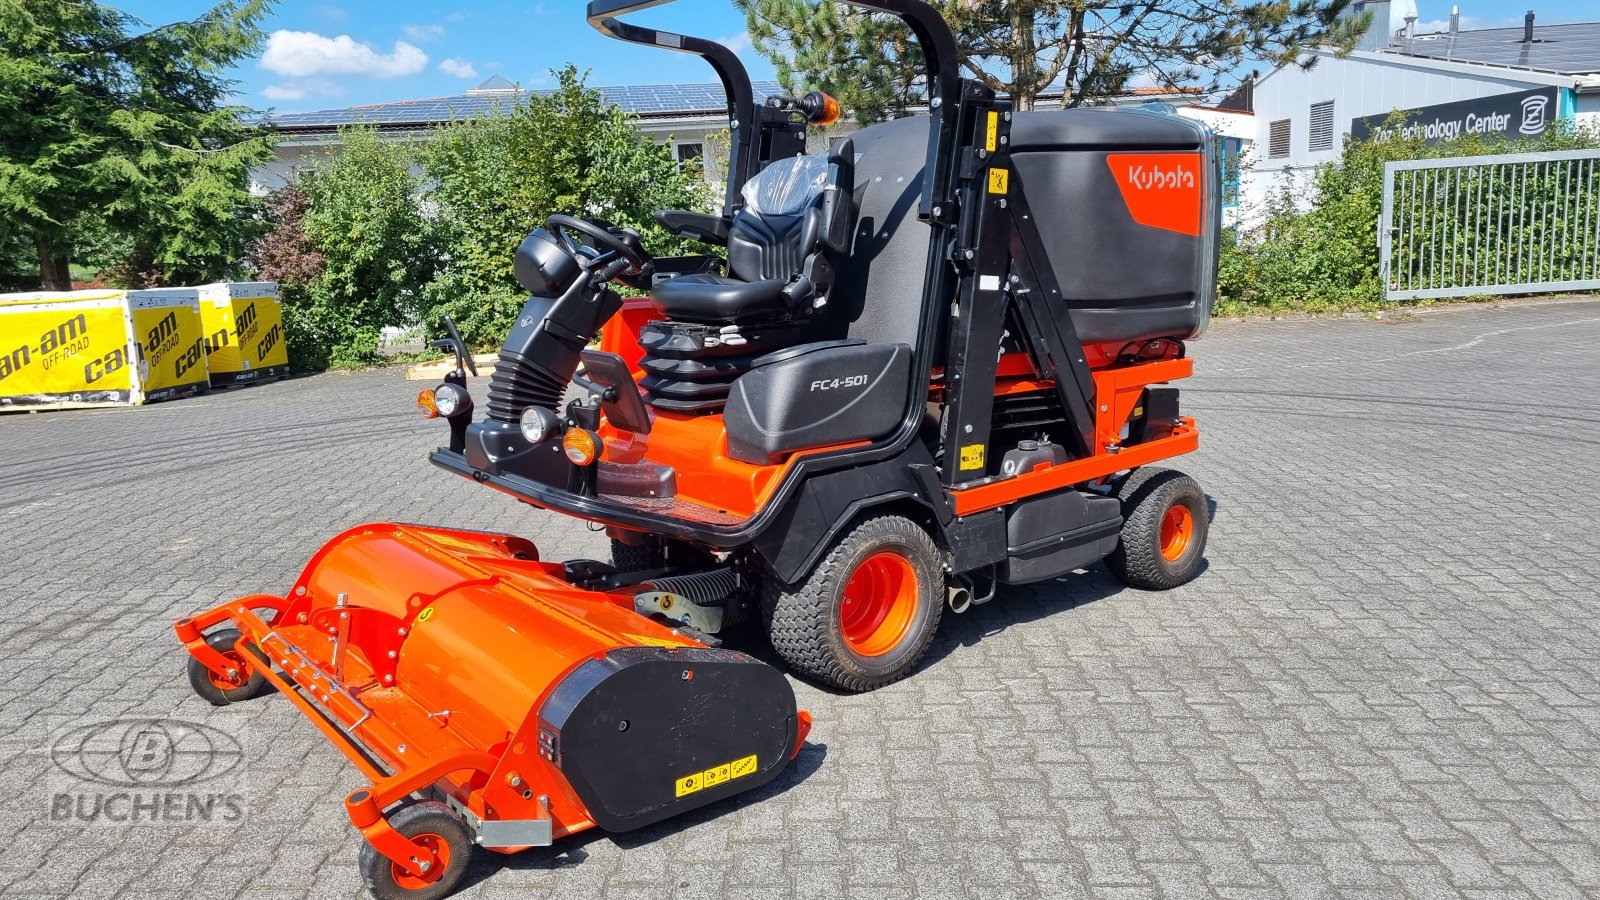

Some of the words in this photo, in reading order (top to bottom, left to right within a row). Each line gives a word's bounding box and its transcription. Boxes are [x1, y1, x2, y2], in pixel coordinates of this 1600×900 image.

[1466, 111, 1511, 134] Center
[1129, 165, 1194, 190] Kubota
[42, 336, 90, 371] OFF-ROAD
[151, 333, 180, 368] OFF-ROAD
[810, 374, 868, 391] FC4-501
